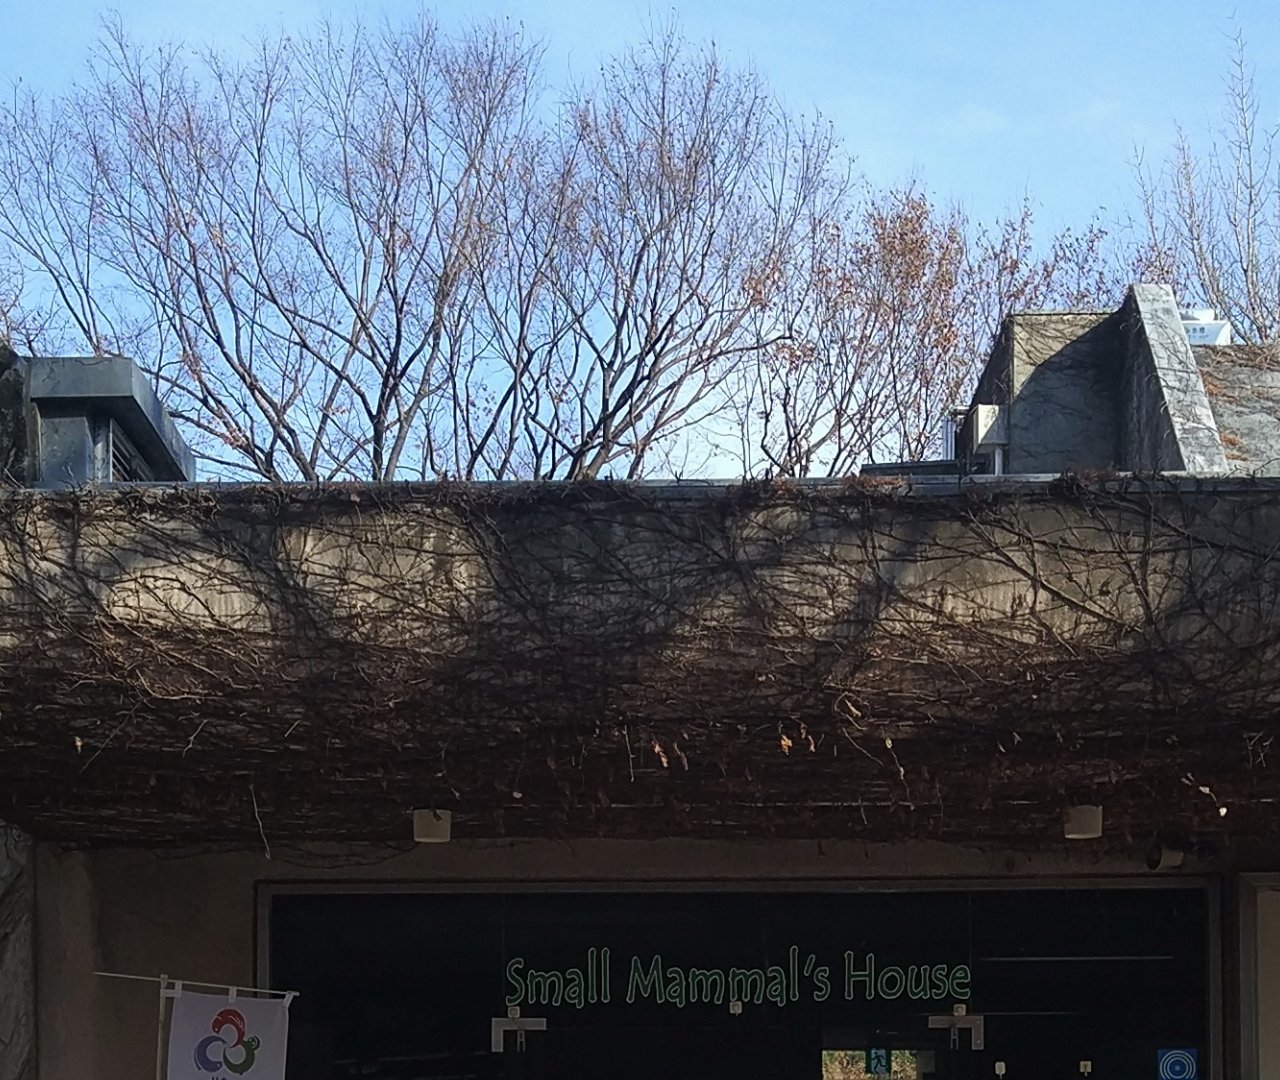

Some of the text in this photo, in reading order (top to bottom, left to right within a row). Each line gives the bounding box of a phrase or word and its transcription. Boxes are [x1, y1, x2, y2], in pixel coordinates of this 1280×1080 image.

[505, 945, 971, 1008] Small Mammal's House
